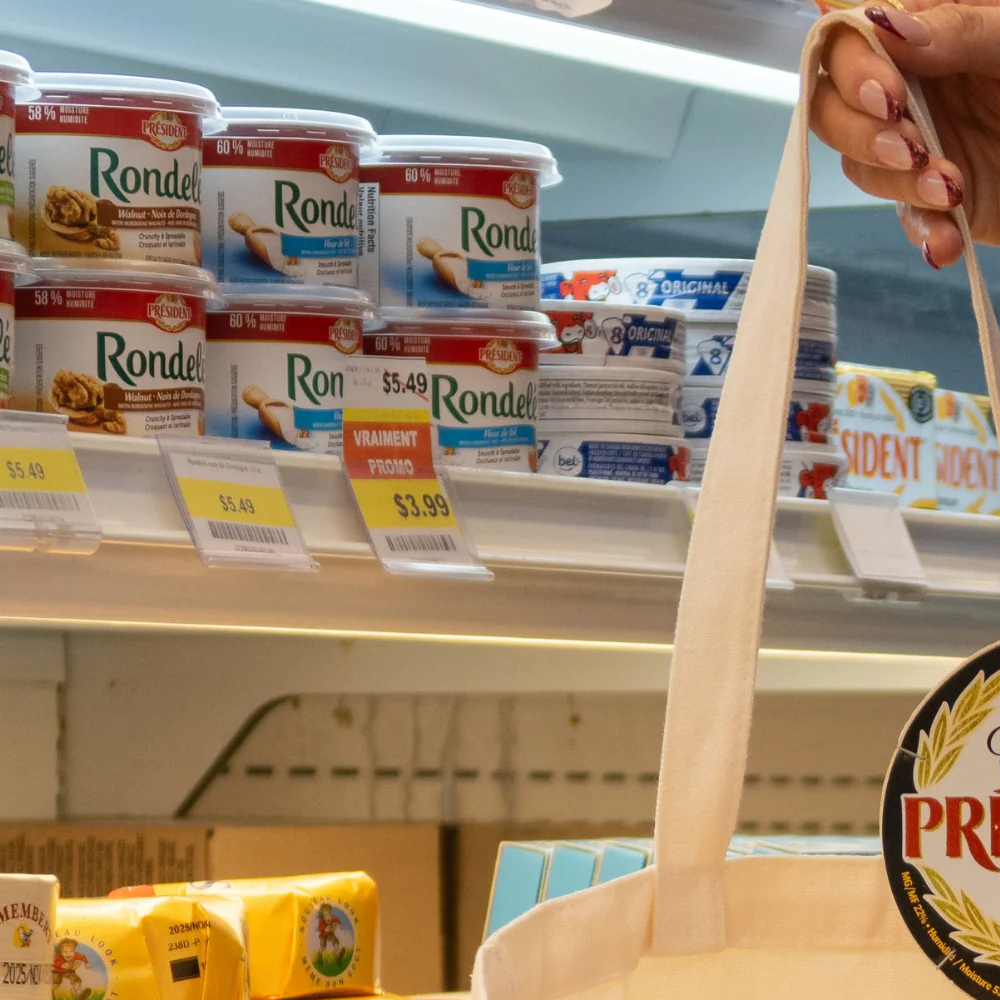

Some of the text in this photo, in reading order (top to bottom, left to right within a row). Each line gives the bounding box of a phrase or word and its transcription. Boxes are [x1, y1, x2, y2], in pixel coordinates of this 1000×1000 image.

[28, 106, 56, 121] 58 %
[59, 106, 89, 115] MOISTURE
[142, 120, 188, 140] PRÉSIDENT
[216, 139, 244, 154] 60 %
[405, 167, 431, 183] 60 %
[118, 209, 146, 219] Walnut
[274, 179, 356, 234] Ronde
[367, 186, 376, 253] Nutrition Facts
[139, 232, 160, 241] Crunchy
[34, 290, 63, 306] 58 %
[66, 290, 96, 299] MOISTURE
[636, 280, 729, 298] 8 ORIGINAL
[148, 302, 192, 320] PRÉSIDENT
[229, 313, 257, 328] 60 %
[375, 336, 401, 351] 60 %
[611, 325, 674, 345] 8 ORIGINAL
[708, 348, 722, 365] 8
[383, 371, 428, 397] $5.49
[124, 391, 152, 402] Walnut
[145, 414, 165, 423] Crunchy
[681, 410, 701, 423] bel
[353, 429, 418, 447] VRAIMENT
[557, 454, 578, 467] bel
[841, 428, 923, 482] SIDENT
[6, 460, 45, 480] $5.49
[367, 458, 415, 476] PROMO
[936, 443, 1000, 492] IDENT
[218, 494, 255, 515] $5.49
[393, 492, 450, 520] $3.99
[0, 903, 52, 945] MEMBERT
[901, 871, 920, 904] MG/MF
[913, 903, 929, 926] 22%
[959, 962, 993, 991] Moisture
[90, 935, 119, 967] LOOK
